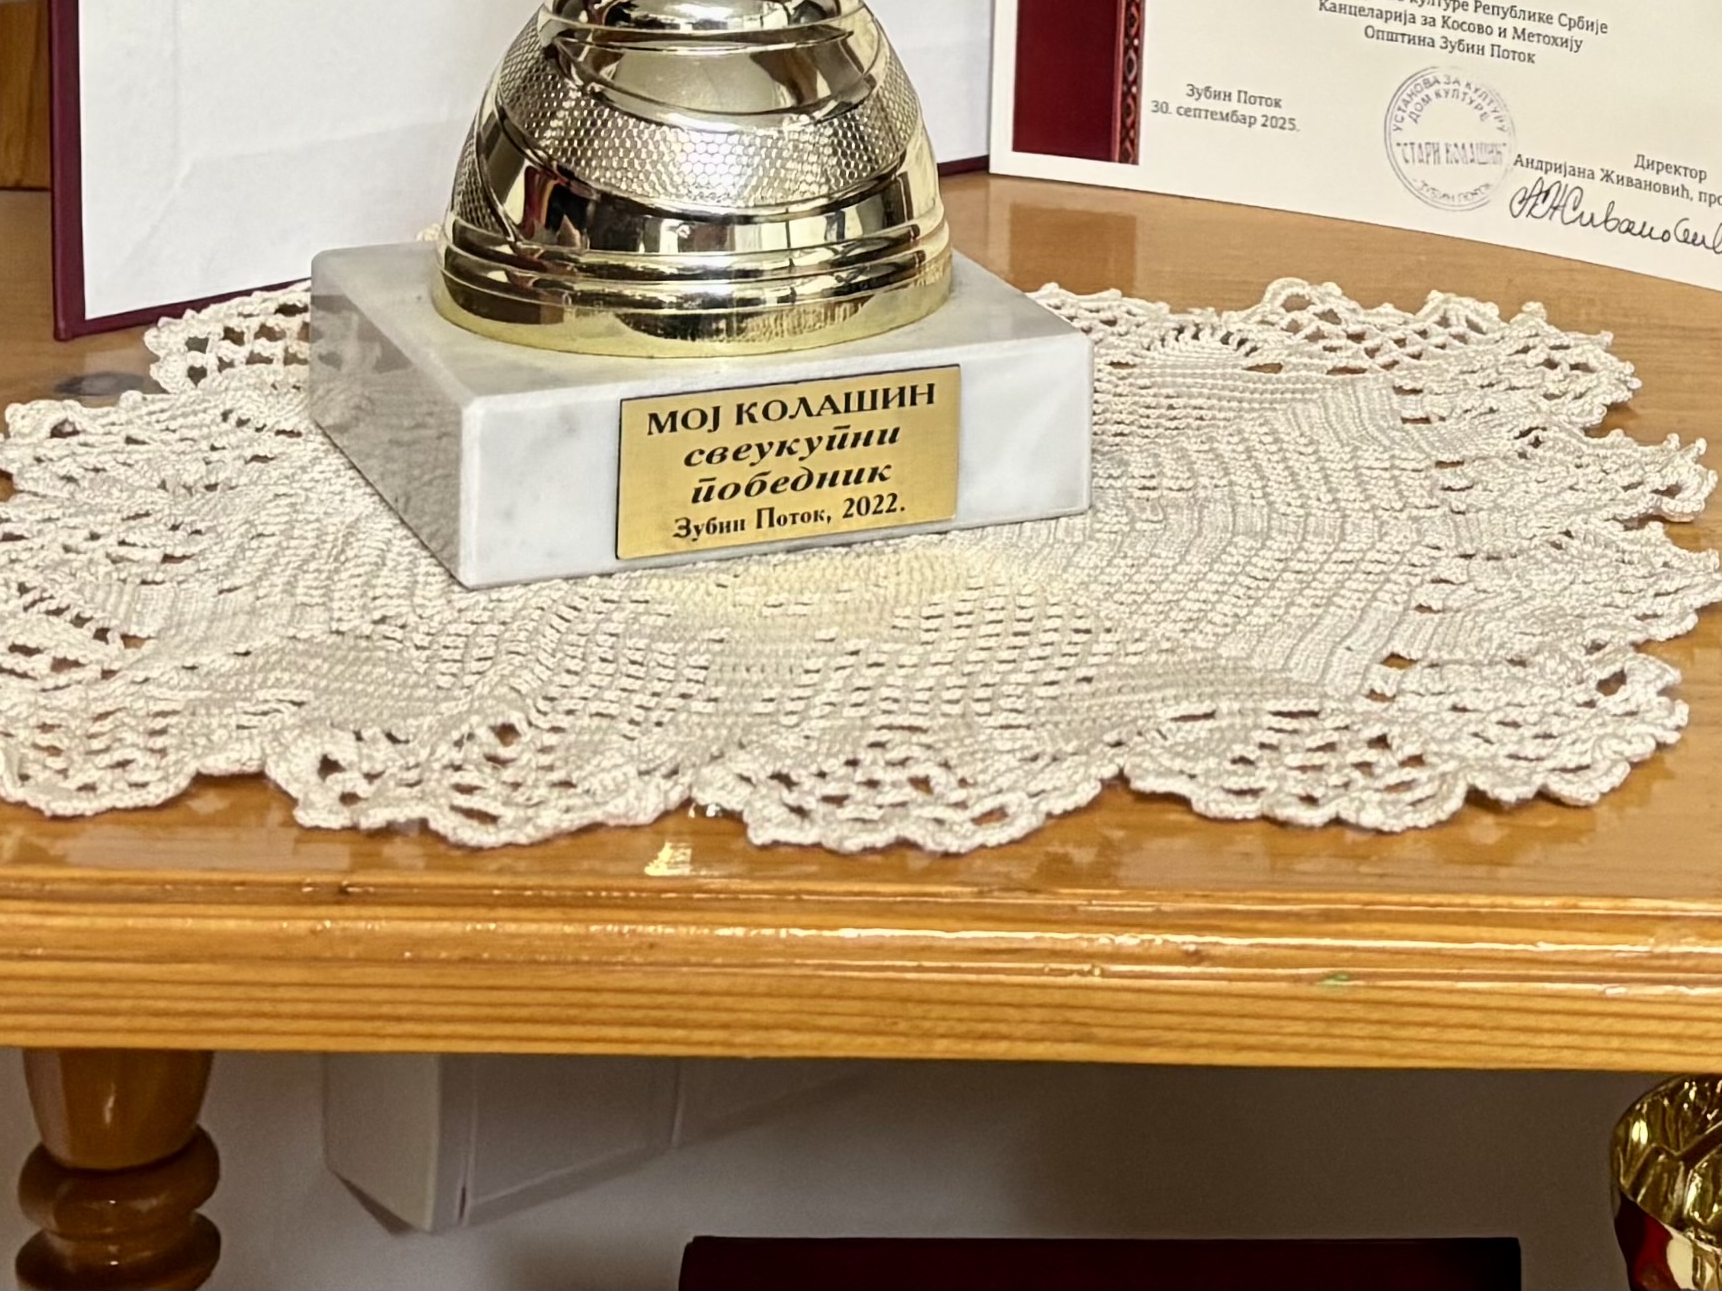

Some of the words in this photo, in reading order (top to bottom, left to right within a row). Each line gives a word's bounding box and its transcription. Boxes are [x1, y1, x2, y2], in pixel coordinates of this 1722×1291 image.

[1421, 15, 1436, 28] за
[1441, 17, 1493, 36] Косово
[1498, 27, 1507, 38] и
[1512, 27, 1583, 52] Метохију
[1473, 0, 1554, 24] Републике
[1558, 13, 1608, 35] Србије
[1364, 25, 1435, 48] Општина
[1440, 37, 1485, 56] Зубин
[1490, 44, 1535, 63] Поток
[1186, 84, 1231, 102] Зубин
[1237, 90, 1282, 108] Поток
[1151, 100, 1172, 114] 30.
[1176, 105, 1257, 128] септембар
[1261, 115, 1301, 132] 2025.
[1513, 154, 1595, 180] Андријана
[1599, 168, 1693, 202] Живановић,
[1634, 154, 1707, 183] Директор
[647, 405, 722, 435] МОЈ
[735, 382, 936, 426] КОЛАШИН
[683, 424, 901, 468] свеукупни
[691, 461, 892, 504] победник
[673, 515, 746, 542] Зубин
[756, 506, 832, 530] Поток,
[841, 492, 906, 519] 2022.
